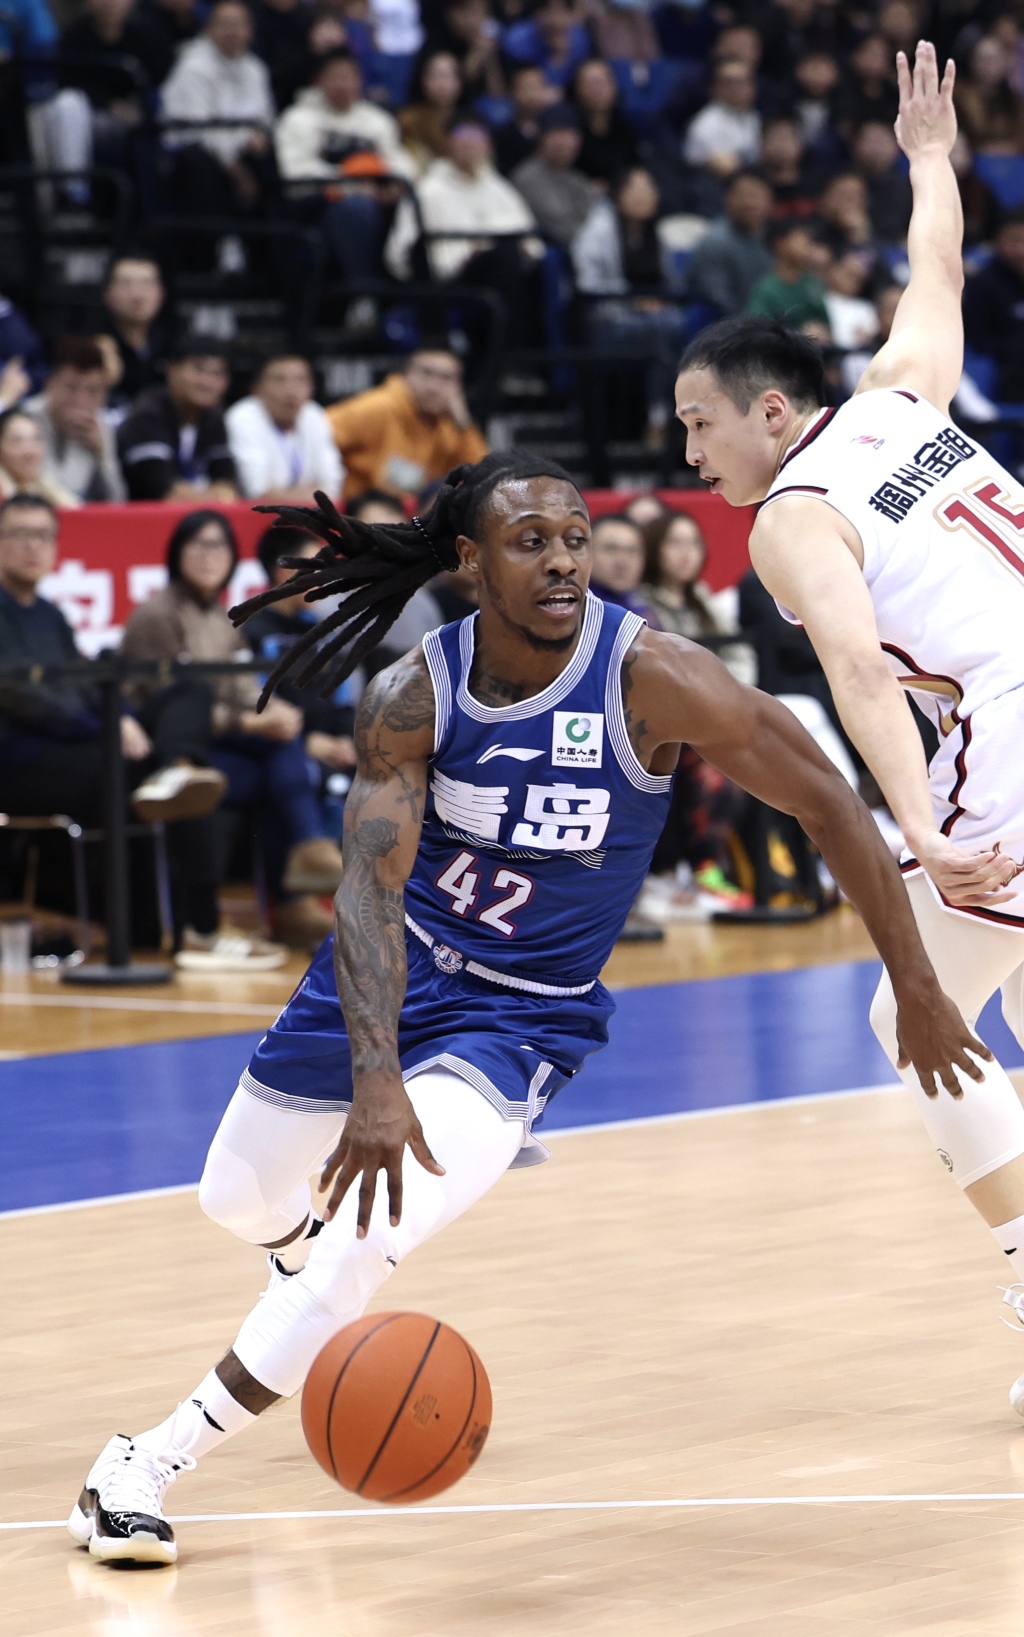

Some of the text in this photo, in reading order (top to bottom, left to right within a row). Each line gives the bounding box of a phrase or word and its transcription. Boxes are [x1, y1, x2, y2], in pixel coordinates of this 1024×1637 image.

[868, 427, 978, 524] 稠州金租
[556, 746, 598, 757] 中国人寿
[430, 767, 611, 851] 青岛
[436, 850, 535, 939] 42
